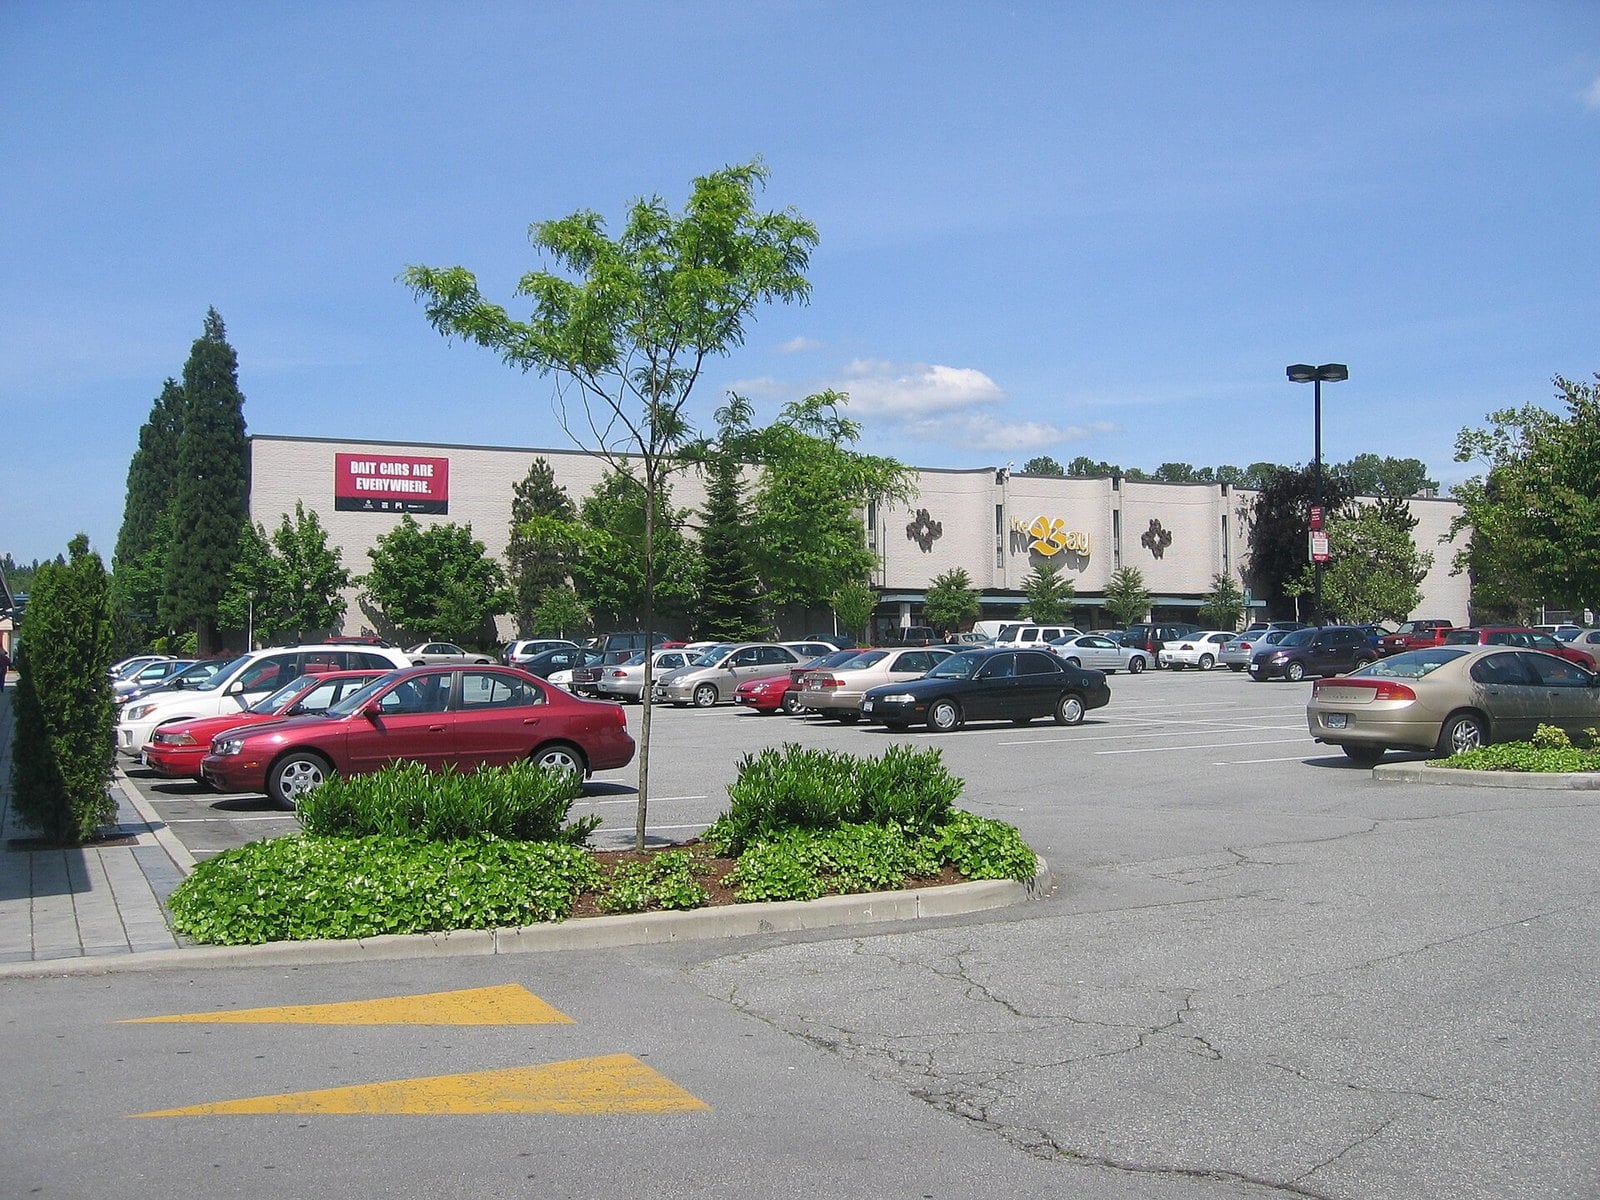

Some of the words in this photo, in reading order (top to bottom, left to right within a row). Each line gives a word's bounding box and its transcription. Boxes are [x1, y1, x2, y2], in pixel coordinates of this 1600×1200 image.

[350, 461, 377, 474] BAIT
[379, 462, 410, 476] CARS
[412, 464, 433, 477] ARE
[355, 477, 432, 493] EVERYWHERE.
